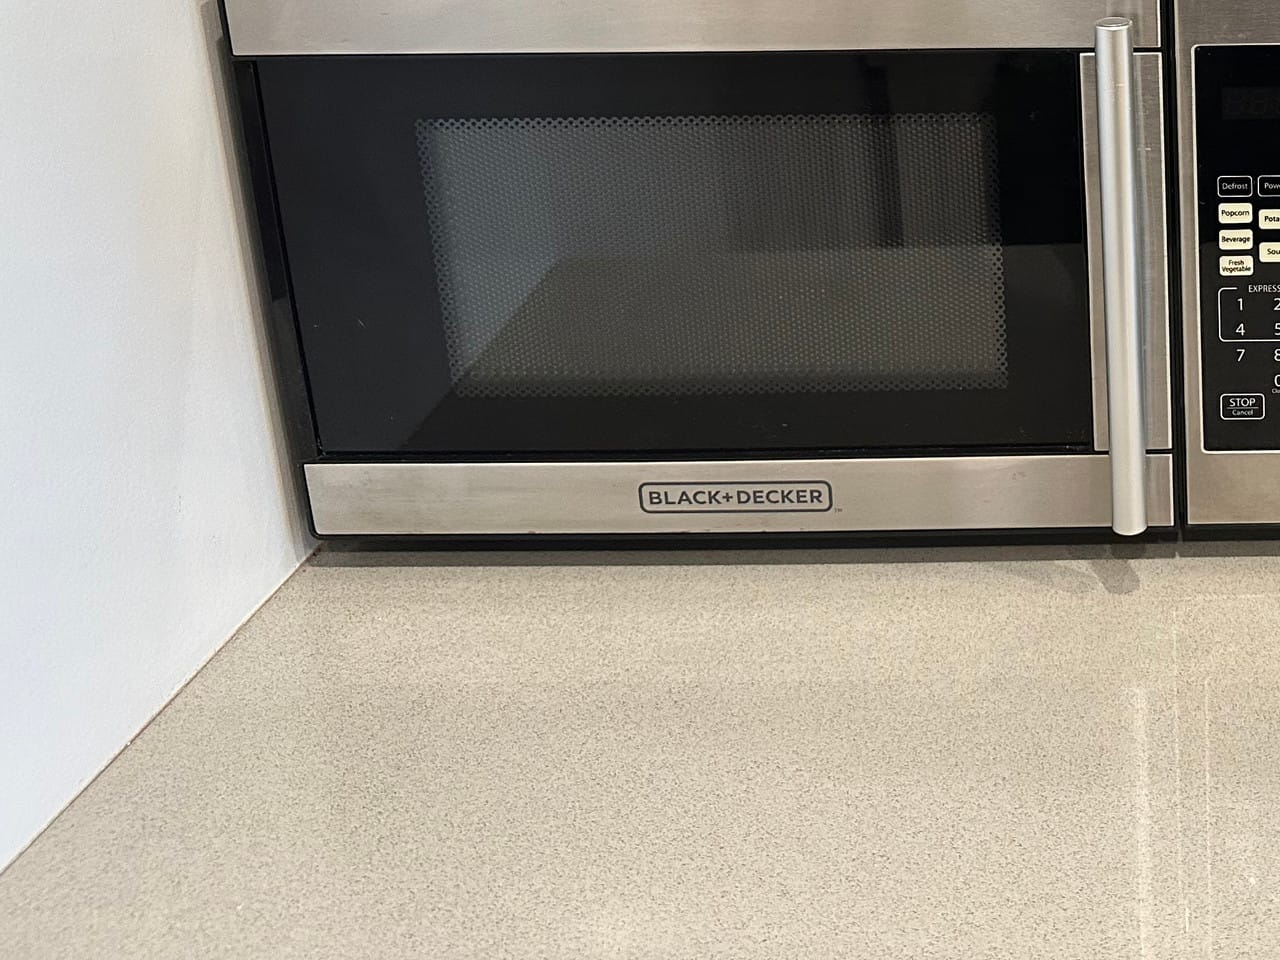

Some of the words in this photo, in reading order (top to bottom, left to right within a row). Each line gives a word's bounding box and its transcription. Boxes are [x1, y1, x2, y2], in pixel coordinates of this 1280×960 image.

[1222, 182, 1248, 190] Defrost
[1221, 209, 1250, 217] Popcorn
[1248, 285, 1280, 293] EXPRESS
[1237, 298, 1243, 311] 1
[1235, 323, 1246, 336] 4
[1236, 349, 1246, 362] 7
[1229, 398, 1256, 407] STOP
[648, 489, 823, 505] BLACK+DECKER
